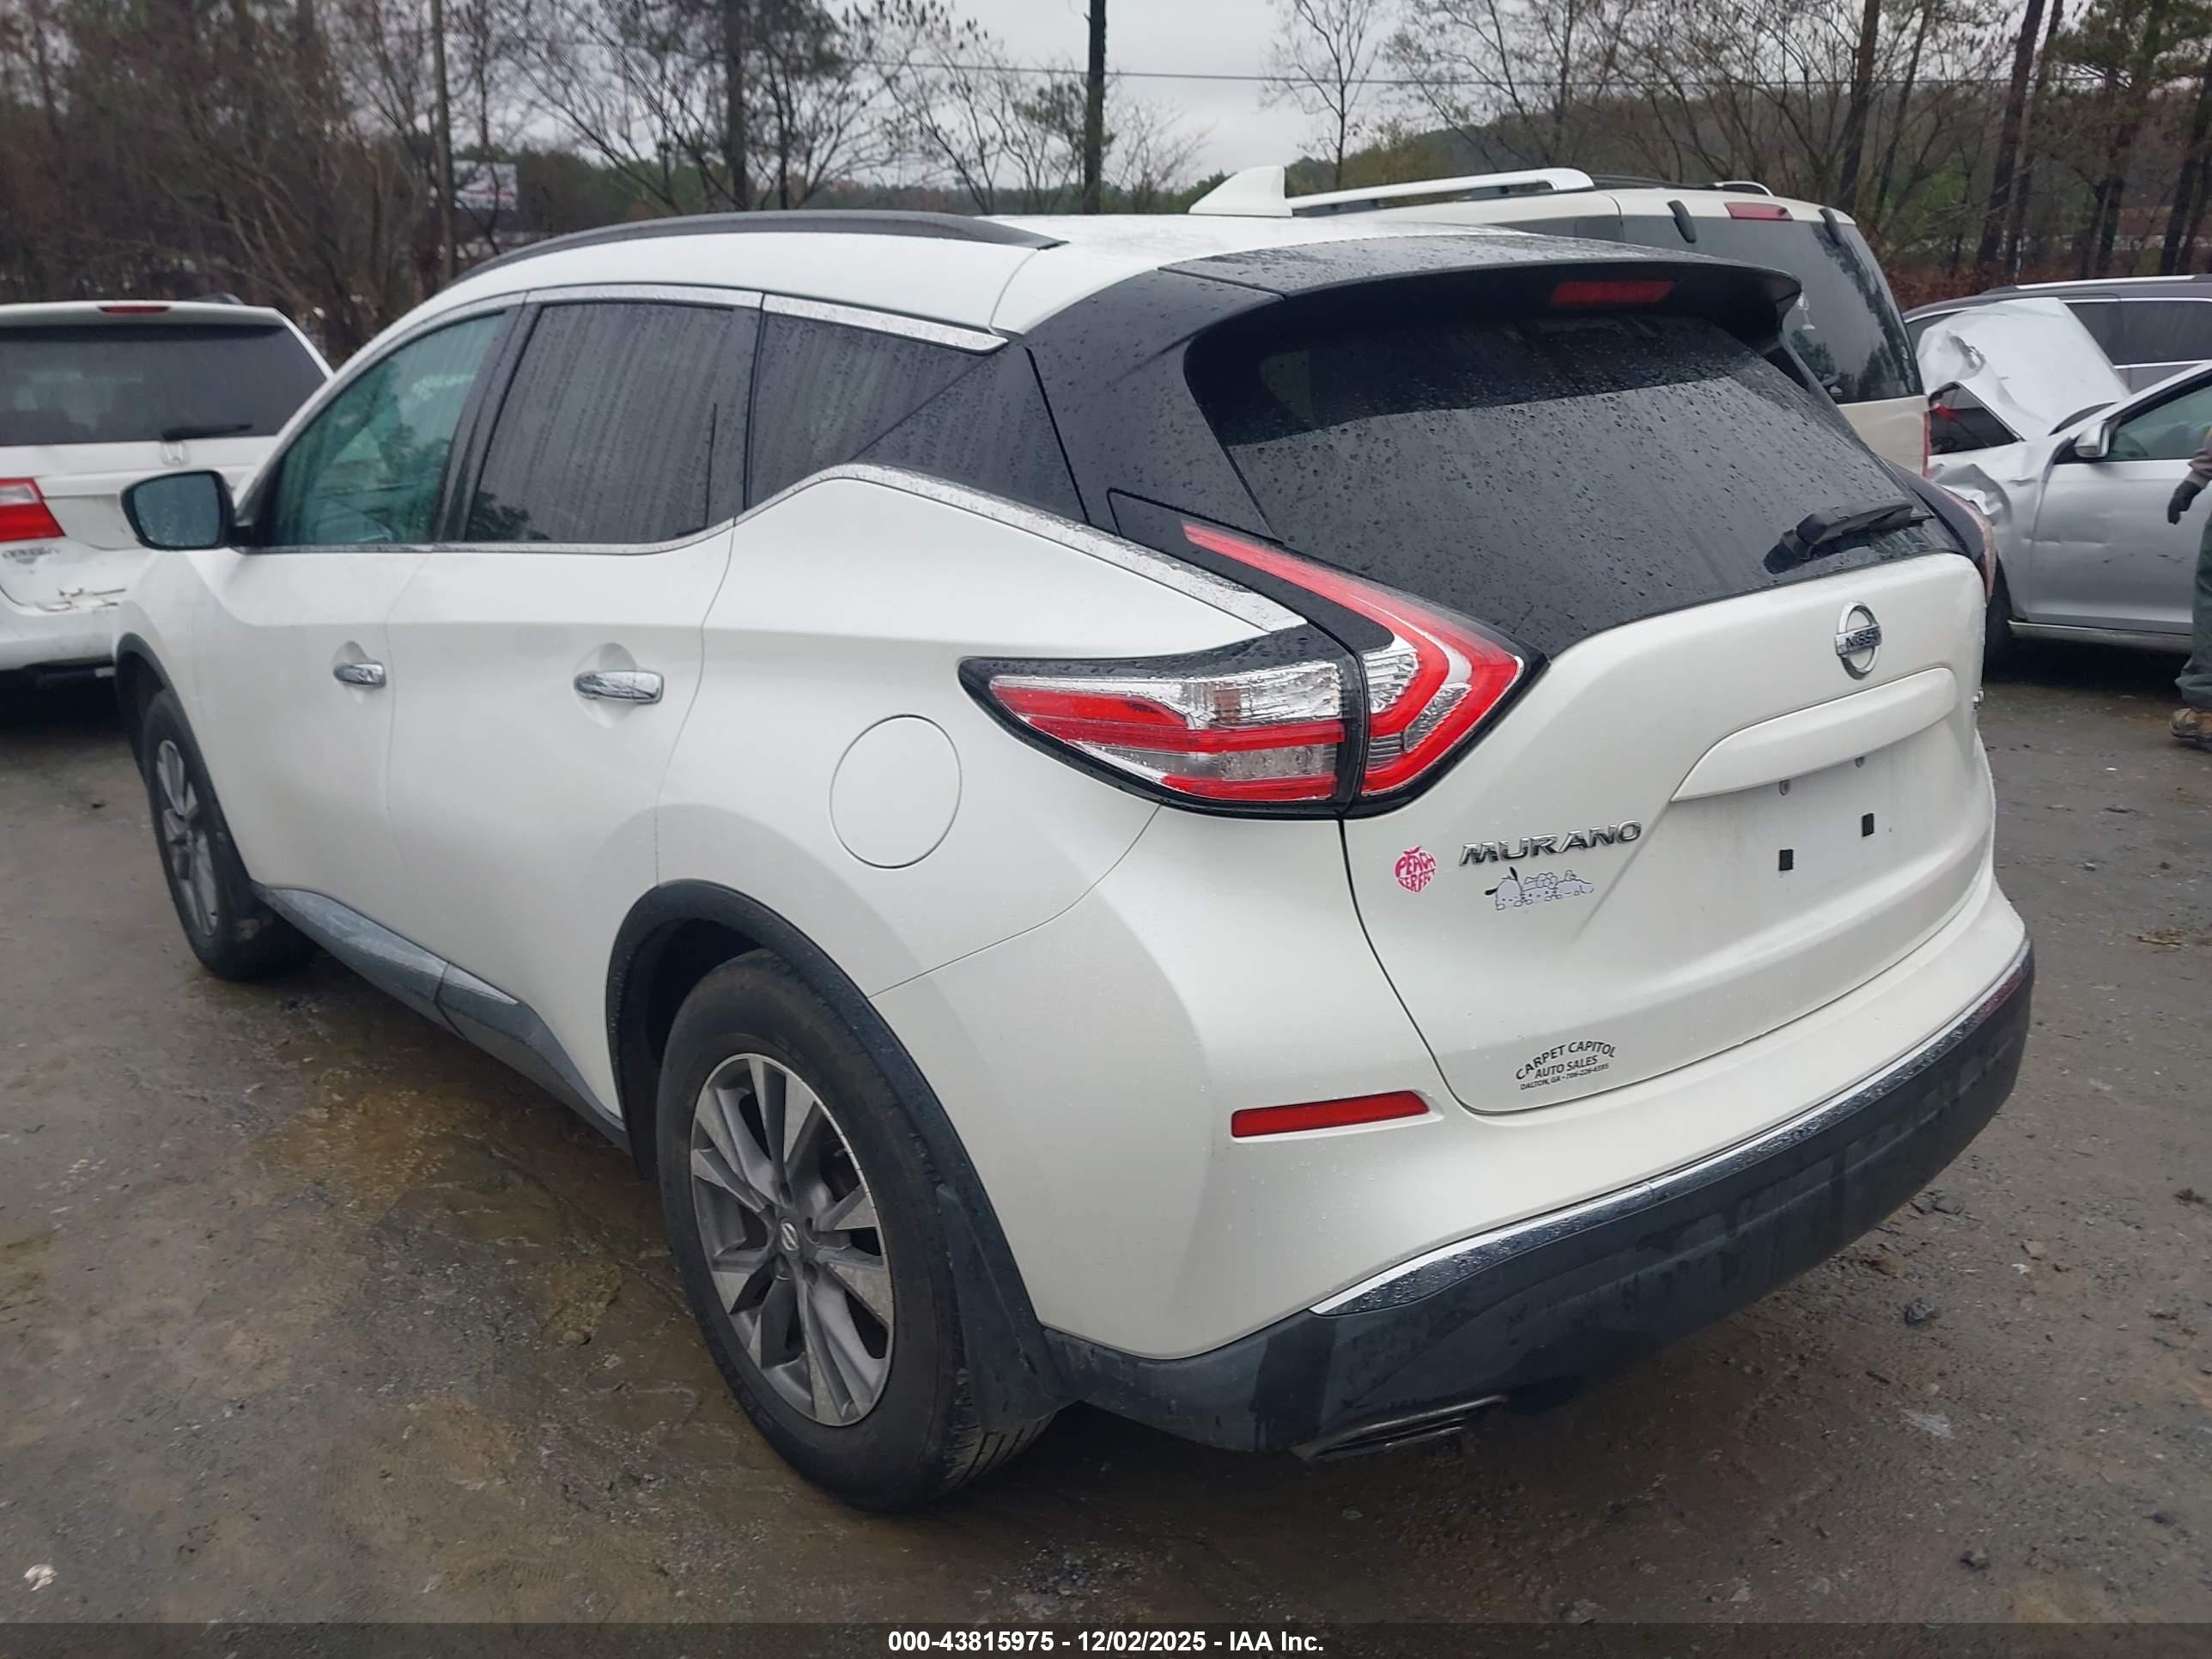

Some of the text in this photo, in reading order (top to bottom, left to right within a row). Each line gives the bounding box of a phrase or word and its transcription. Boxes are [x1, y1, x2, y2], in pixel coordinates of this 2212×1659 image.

[1460, 820, 1642, 866] MURANO
[1395, 852, 1436, 877] PEACH
[1516, 1041, 1616, 1079] CARPET CAPITOL
[1534, 1055, 1597, 1079] AUTO SALES
